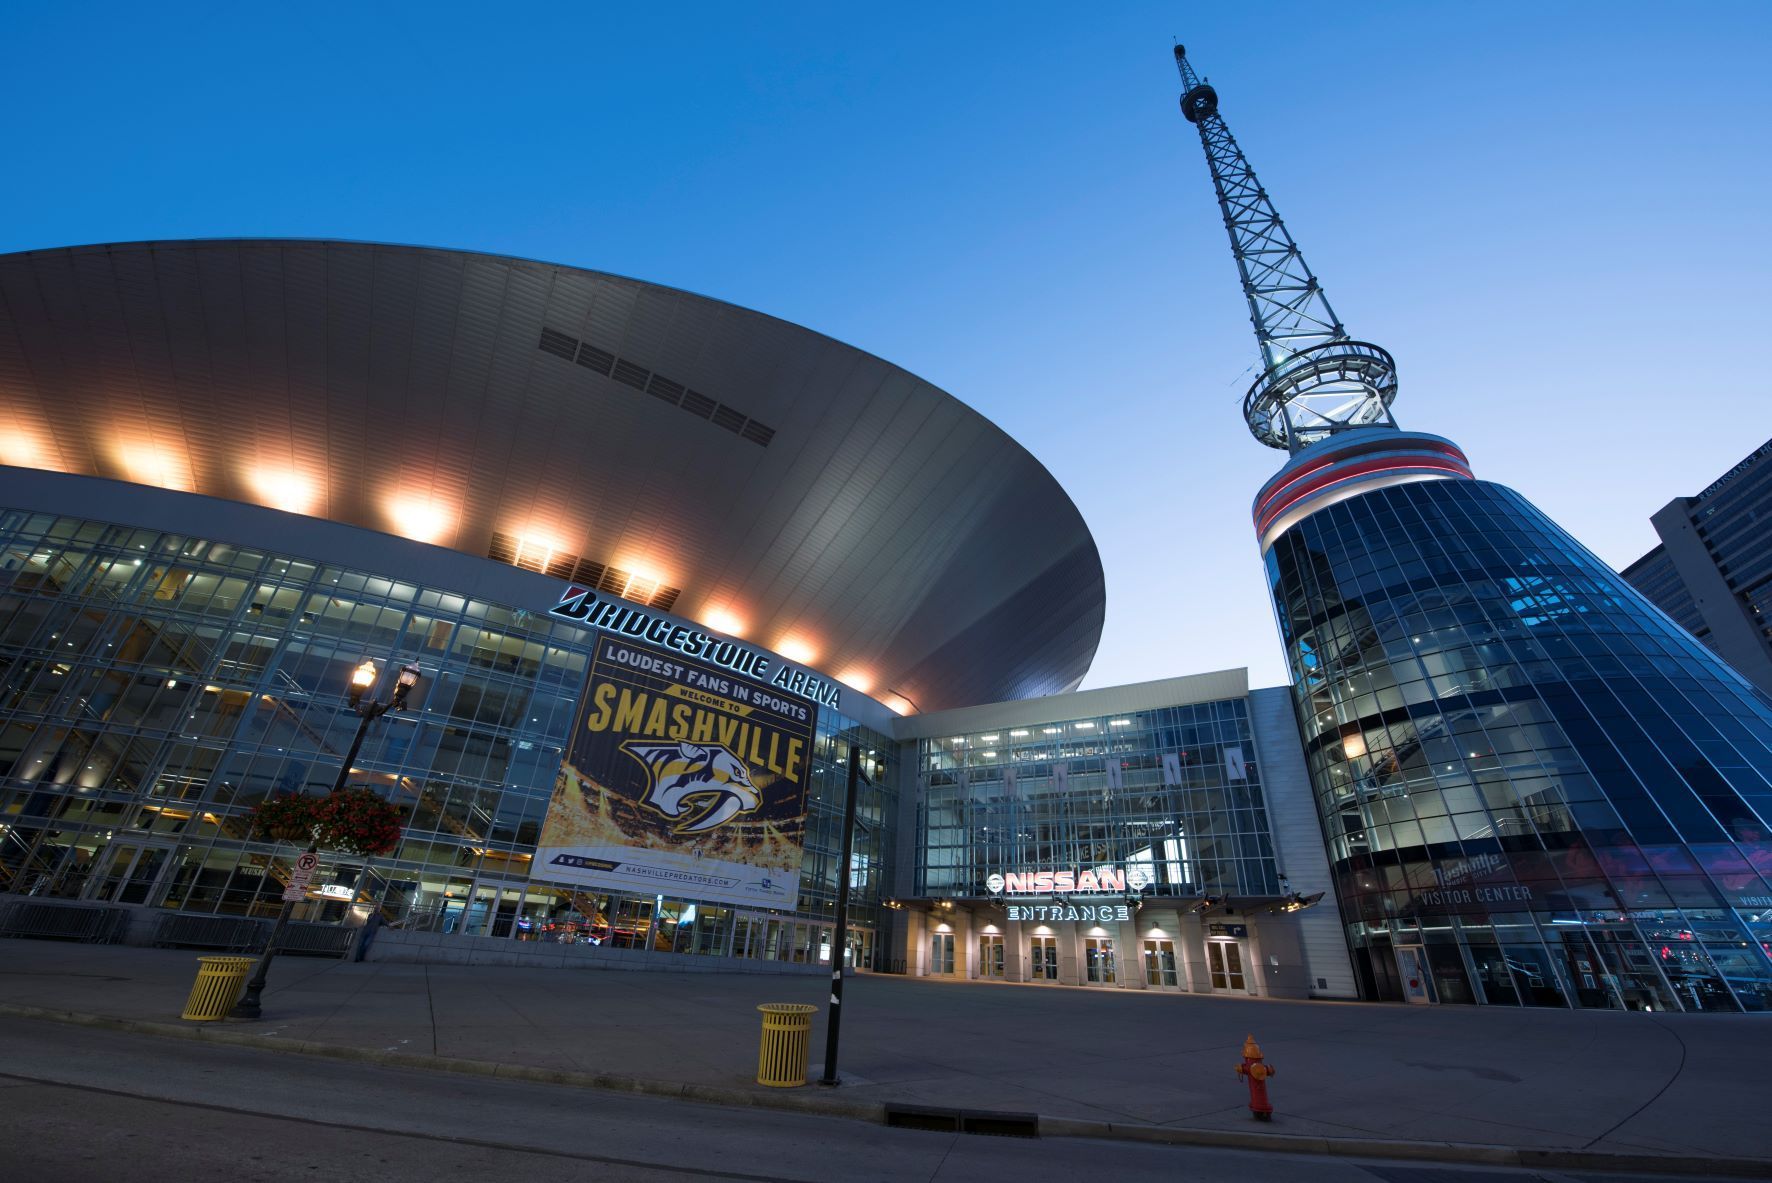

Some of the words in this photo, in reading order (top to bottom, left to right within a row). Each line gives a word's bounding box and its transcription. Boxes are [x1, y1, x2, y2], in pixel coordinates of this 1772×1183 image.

[1698, 455, 1758, 501] RENAISSANCE
[549, 586, 769, 679] BRIDGESTONE
[772, 665, 842, 710] ARENA
[605, 646, 684, 679] LOUDEST
[687, 669, 729, 693] FANS
[732, 684, 749, 701] IN
[752, 692, 807, 719] SPORTS
[680, 688, 726, 708] WELCOME
[729, 702, 740, 712] TO
[588, 683, 803, 784] SMASHVILLE
[625, 865, 730, 887] NASHVILLEPREDATORS.COM
[1005, 869, 1126, 893] NISSAN
[1420, 889, 1472, 906] VISITOR
[1475, 886, 1533, 903] CENTER
[1007, 905, 1130, 922] ENTRANCE
